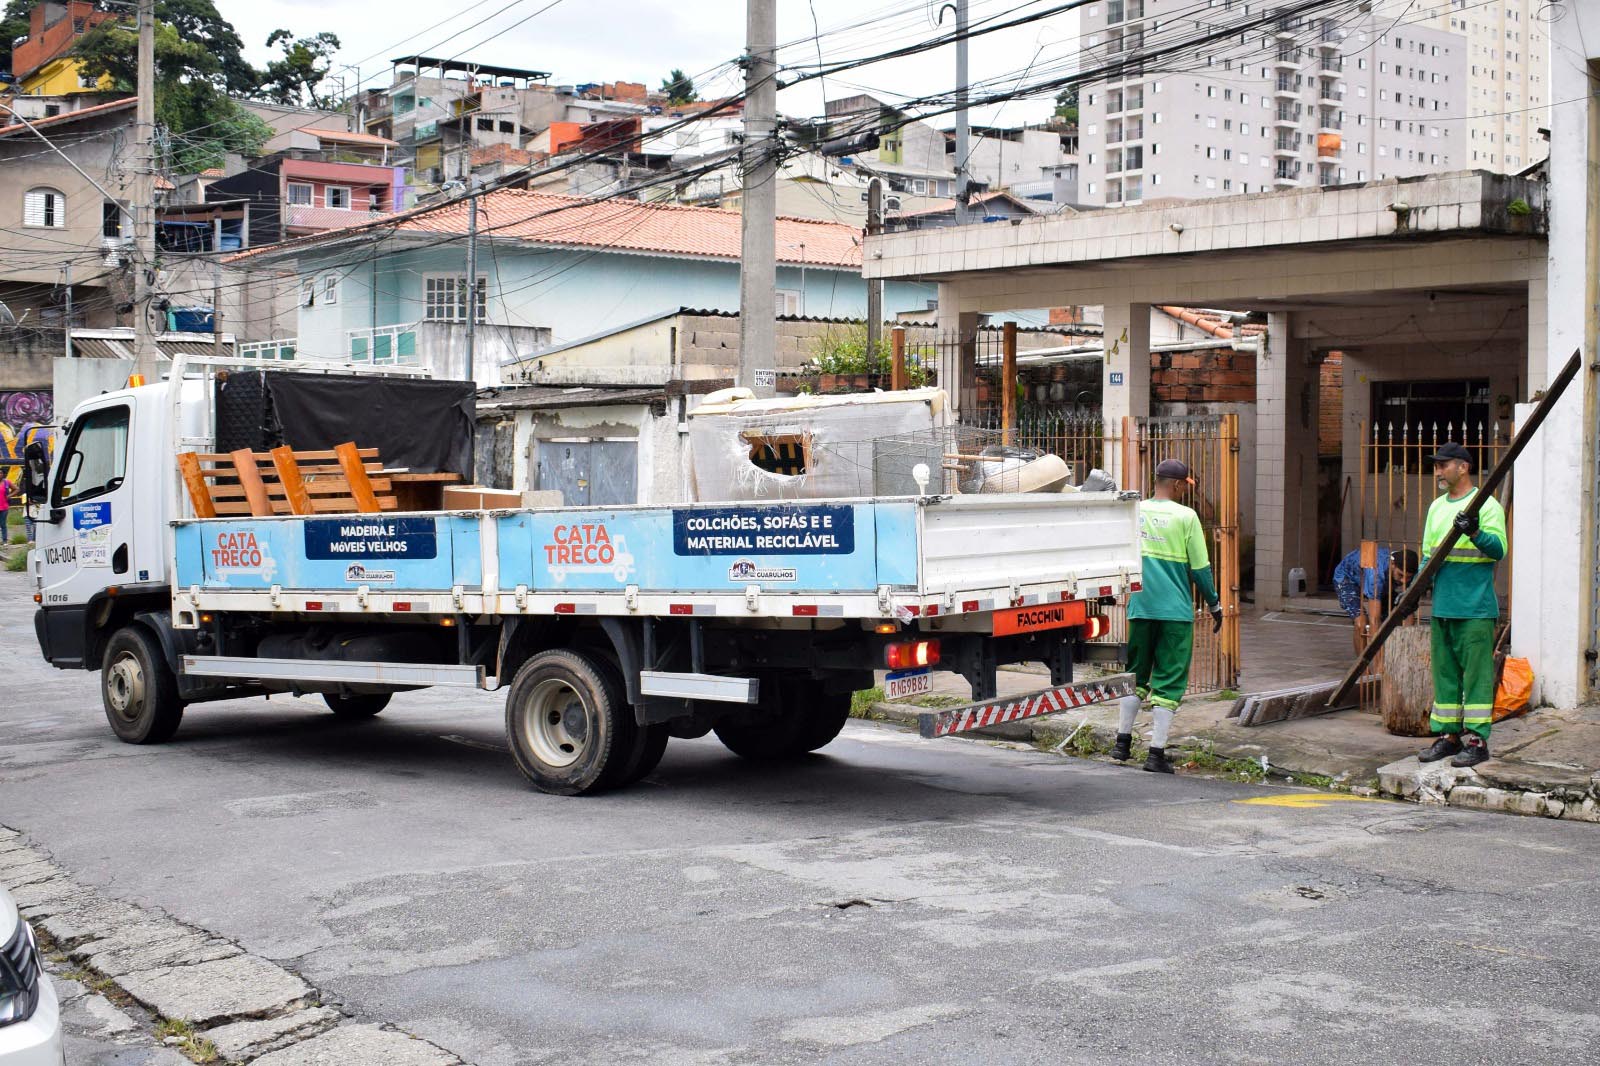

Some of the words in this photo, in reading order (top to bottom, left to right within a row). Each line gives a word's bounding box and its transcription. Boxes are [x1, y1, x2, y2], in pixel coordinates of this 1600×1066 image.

[1111, 374, 1121, 383] 144
[340, 525, 386, 537] MADEIRA
[388, 525, 395, 536] E
[687, 515, 761, 531] COLCHÕES,
[763, 513, 807, 529] SOFÁS
[810, 516, 820, 528] E
[823, 515, 832, 528] E
[217, 532, 258, 550] CATA
[553, 524, 611, 545] CATA
[687, 536, 754, 549] MATERIAL
[756, 532, 839, 548] RECICLÁVEL
[45, 545, 77, 565] VCA-004
[367, 541, 408, 552] VELHOS
[543, 543, 615, 565] TRECO
[211, 549, 262, 567] TRECO
[48, 594, 69, 602] 1016
[1017, 607, 1064, 627] FACCHINI
